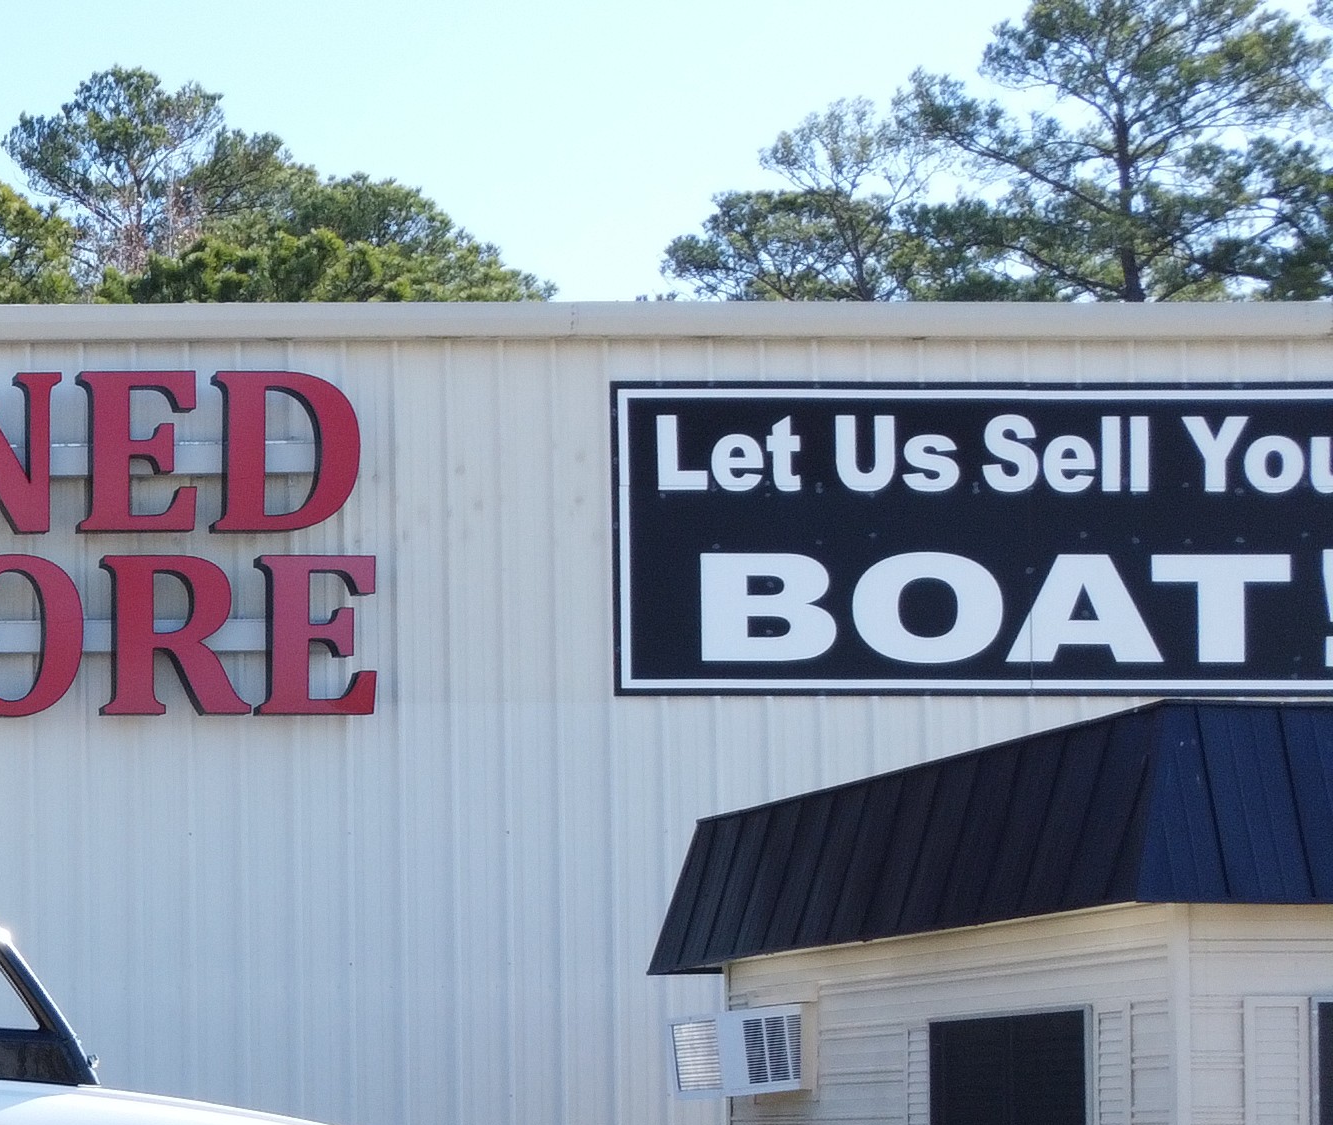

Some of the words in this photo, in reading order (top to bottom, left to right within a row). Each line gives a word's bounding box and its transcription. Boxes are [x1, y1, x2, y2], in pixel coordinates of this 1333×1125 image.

[655, 413, 802, 492] Let
[834, 413, 961, 492] Us
[982, 413, 1150, 493] Sell
[699, 549, 1333, 668] BOAT
